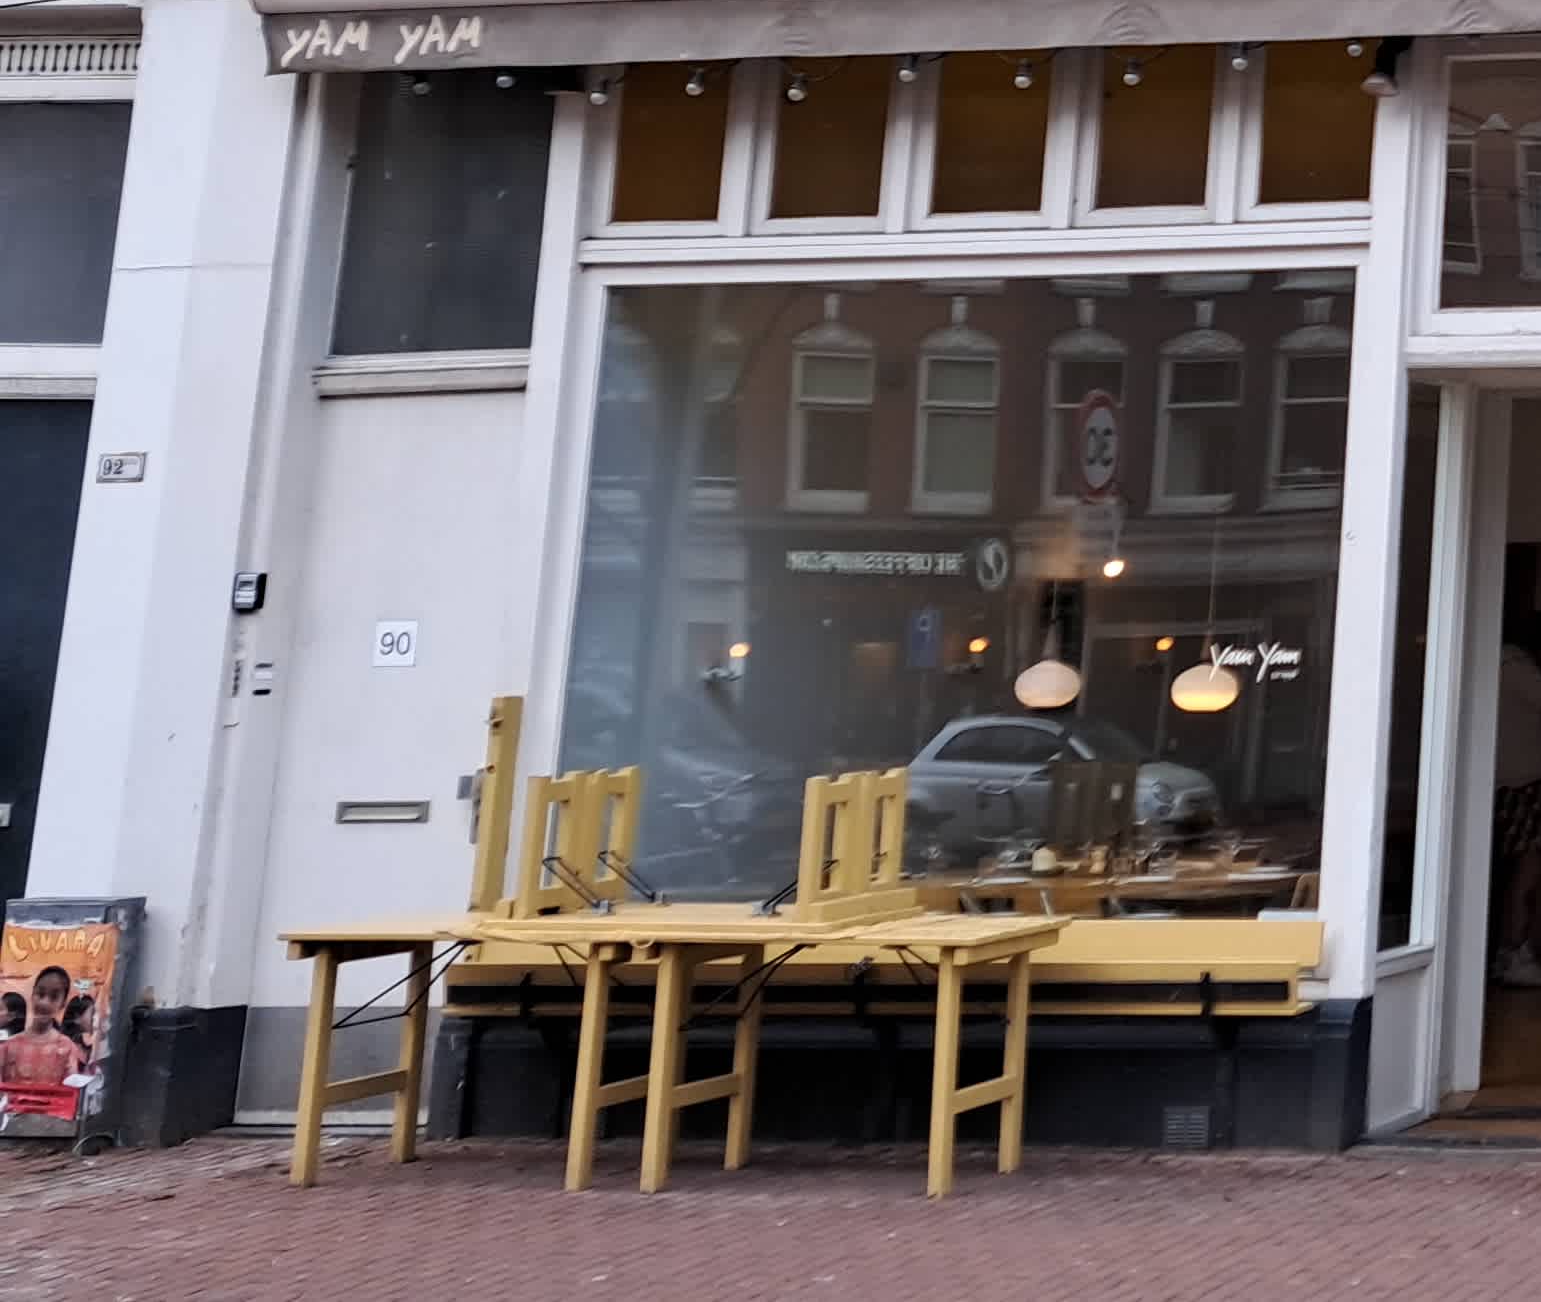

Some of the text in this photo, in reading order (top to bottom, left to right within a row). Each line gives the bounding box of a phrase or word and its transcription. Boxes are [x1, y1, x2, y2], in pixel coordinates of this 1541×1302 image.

[280, 14, 481, 67] YAM YAM
[103, 458, 123, 476] 92
[380, 632, 410, 655] 90
[1208, 641, 1302, 683] Yam Yam
